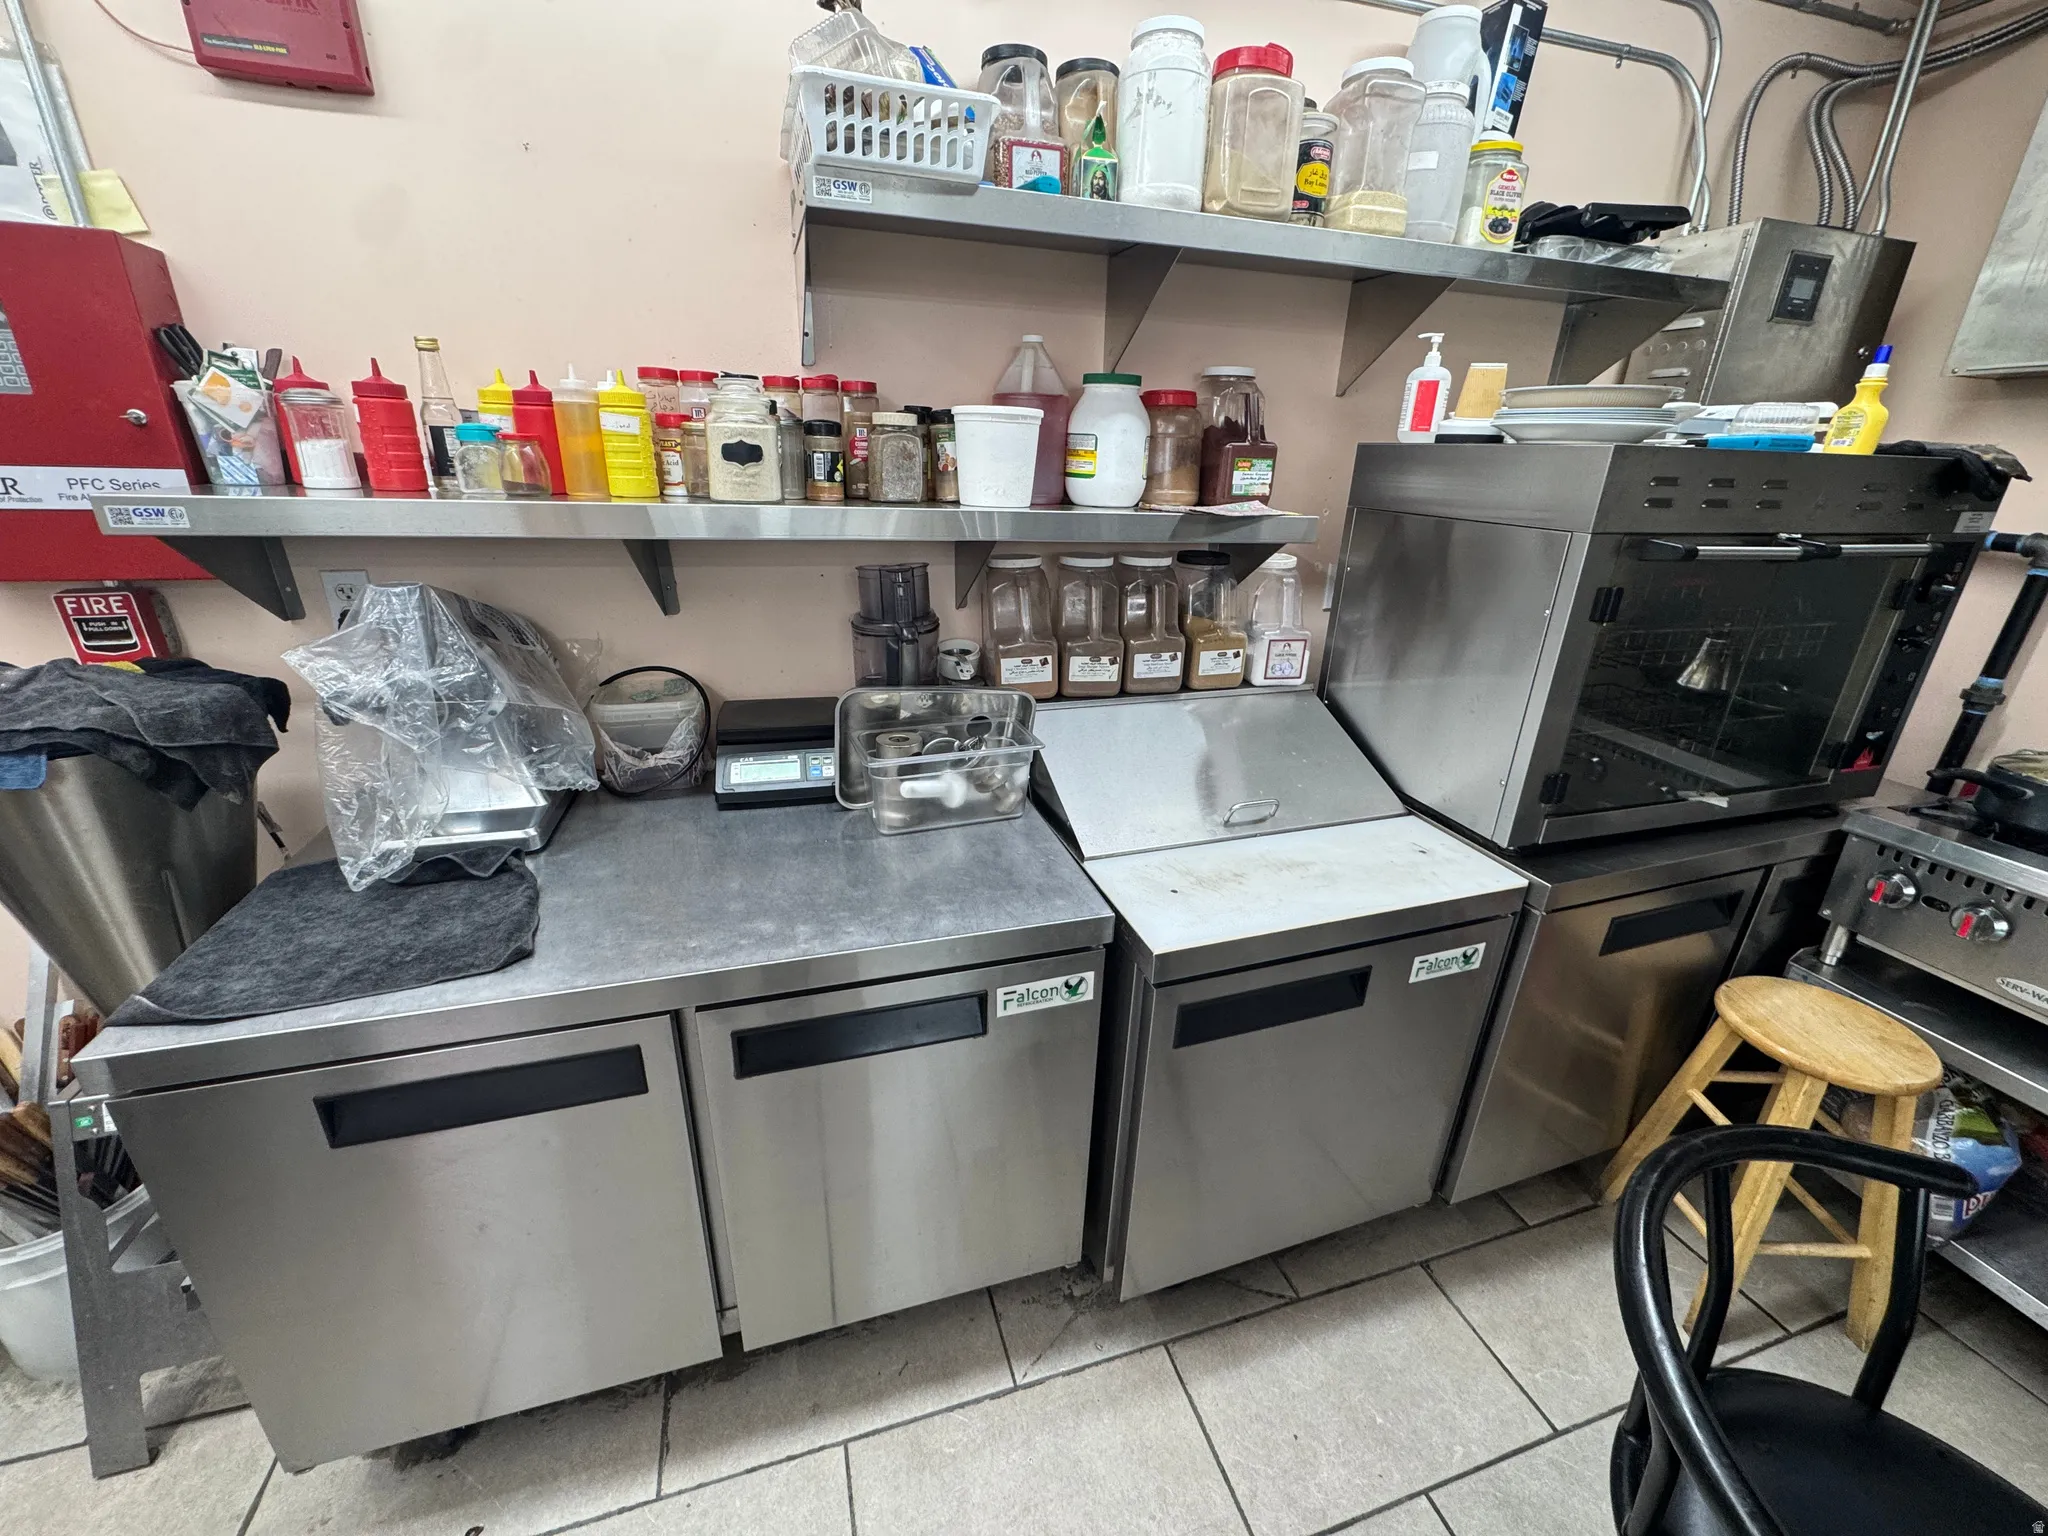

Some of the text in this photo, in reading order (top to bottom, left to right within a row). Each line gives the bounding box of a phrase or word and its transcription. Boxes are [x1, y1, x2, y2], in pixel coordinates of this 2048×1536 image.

[832, 179, 857, 192] GSW
[66, 478, 161, 491] PFC Series
[58, 493, 79, 501] Fire
[132, 507, 166, 518] GSW
[63, 596, 129, 615] FIRE
[1416, 956, 1458, 978] Falcon
[1003, 985, 1059, 1011] Falcon
[1017, 997, 1054, 1009] REFRIGERATION
[1932, 1099, 1954, 1152] GARBANZO
